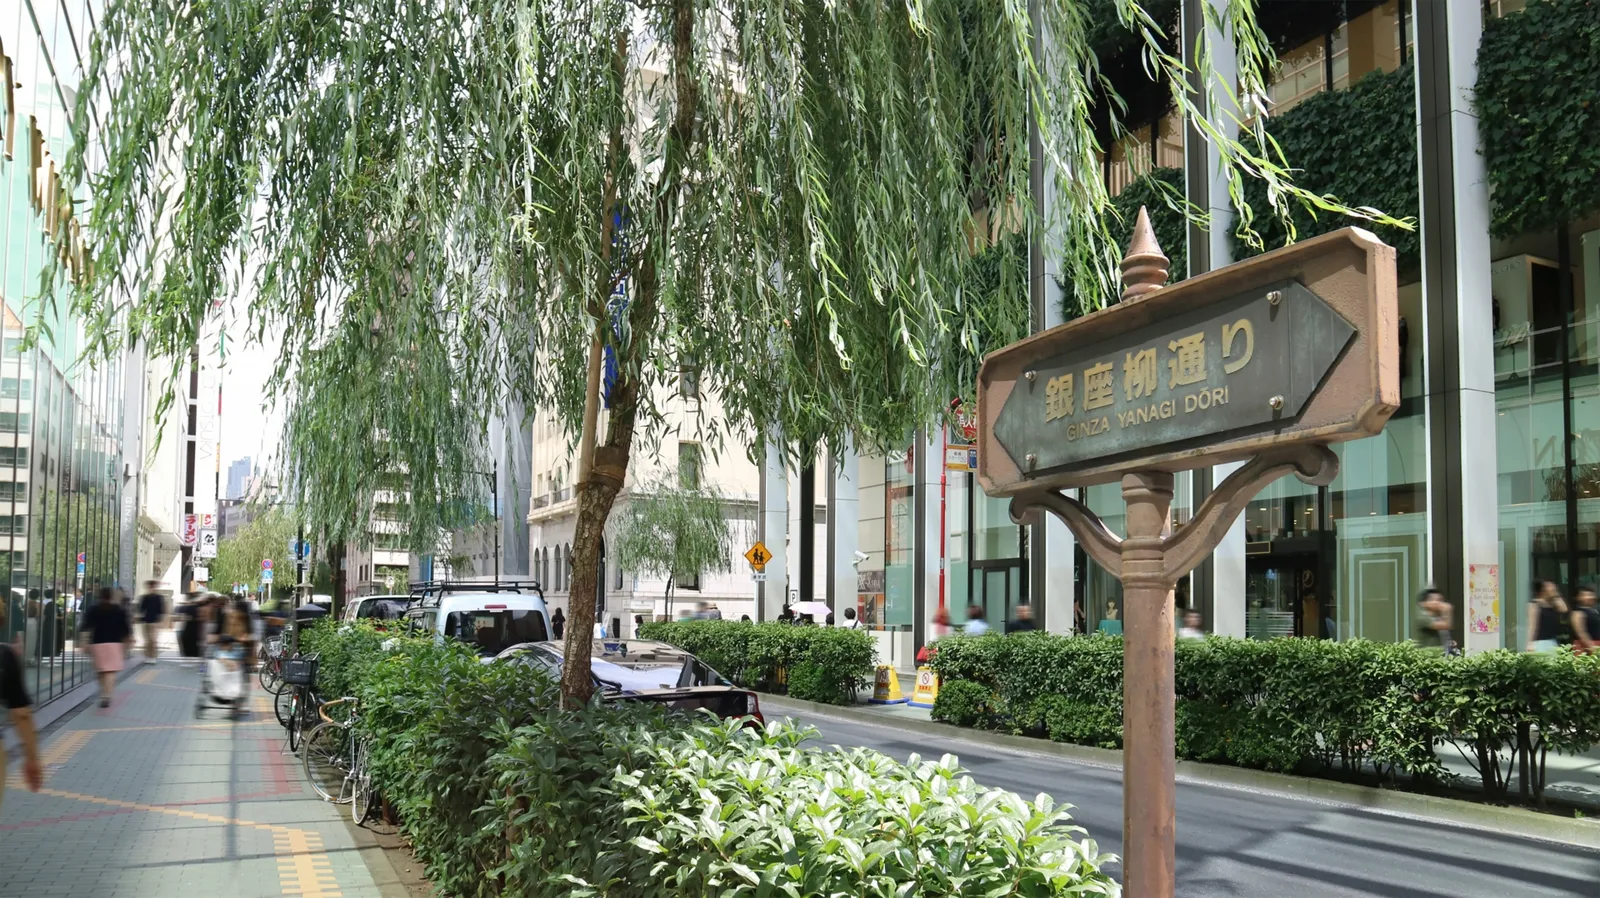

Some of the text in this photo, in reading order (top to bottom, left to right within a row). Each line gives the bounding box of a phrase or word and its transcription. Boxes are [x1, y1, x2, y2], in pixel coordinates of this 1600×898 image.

[1046, 318, 1255, 424] 銀座柳通り
[1066, 385, 1230, 442] GINZA YANAGI DŌRI
[124, 496, 133, 531] GINZA
[185, 514, 196, 543] ラーメン
